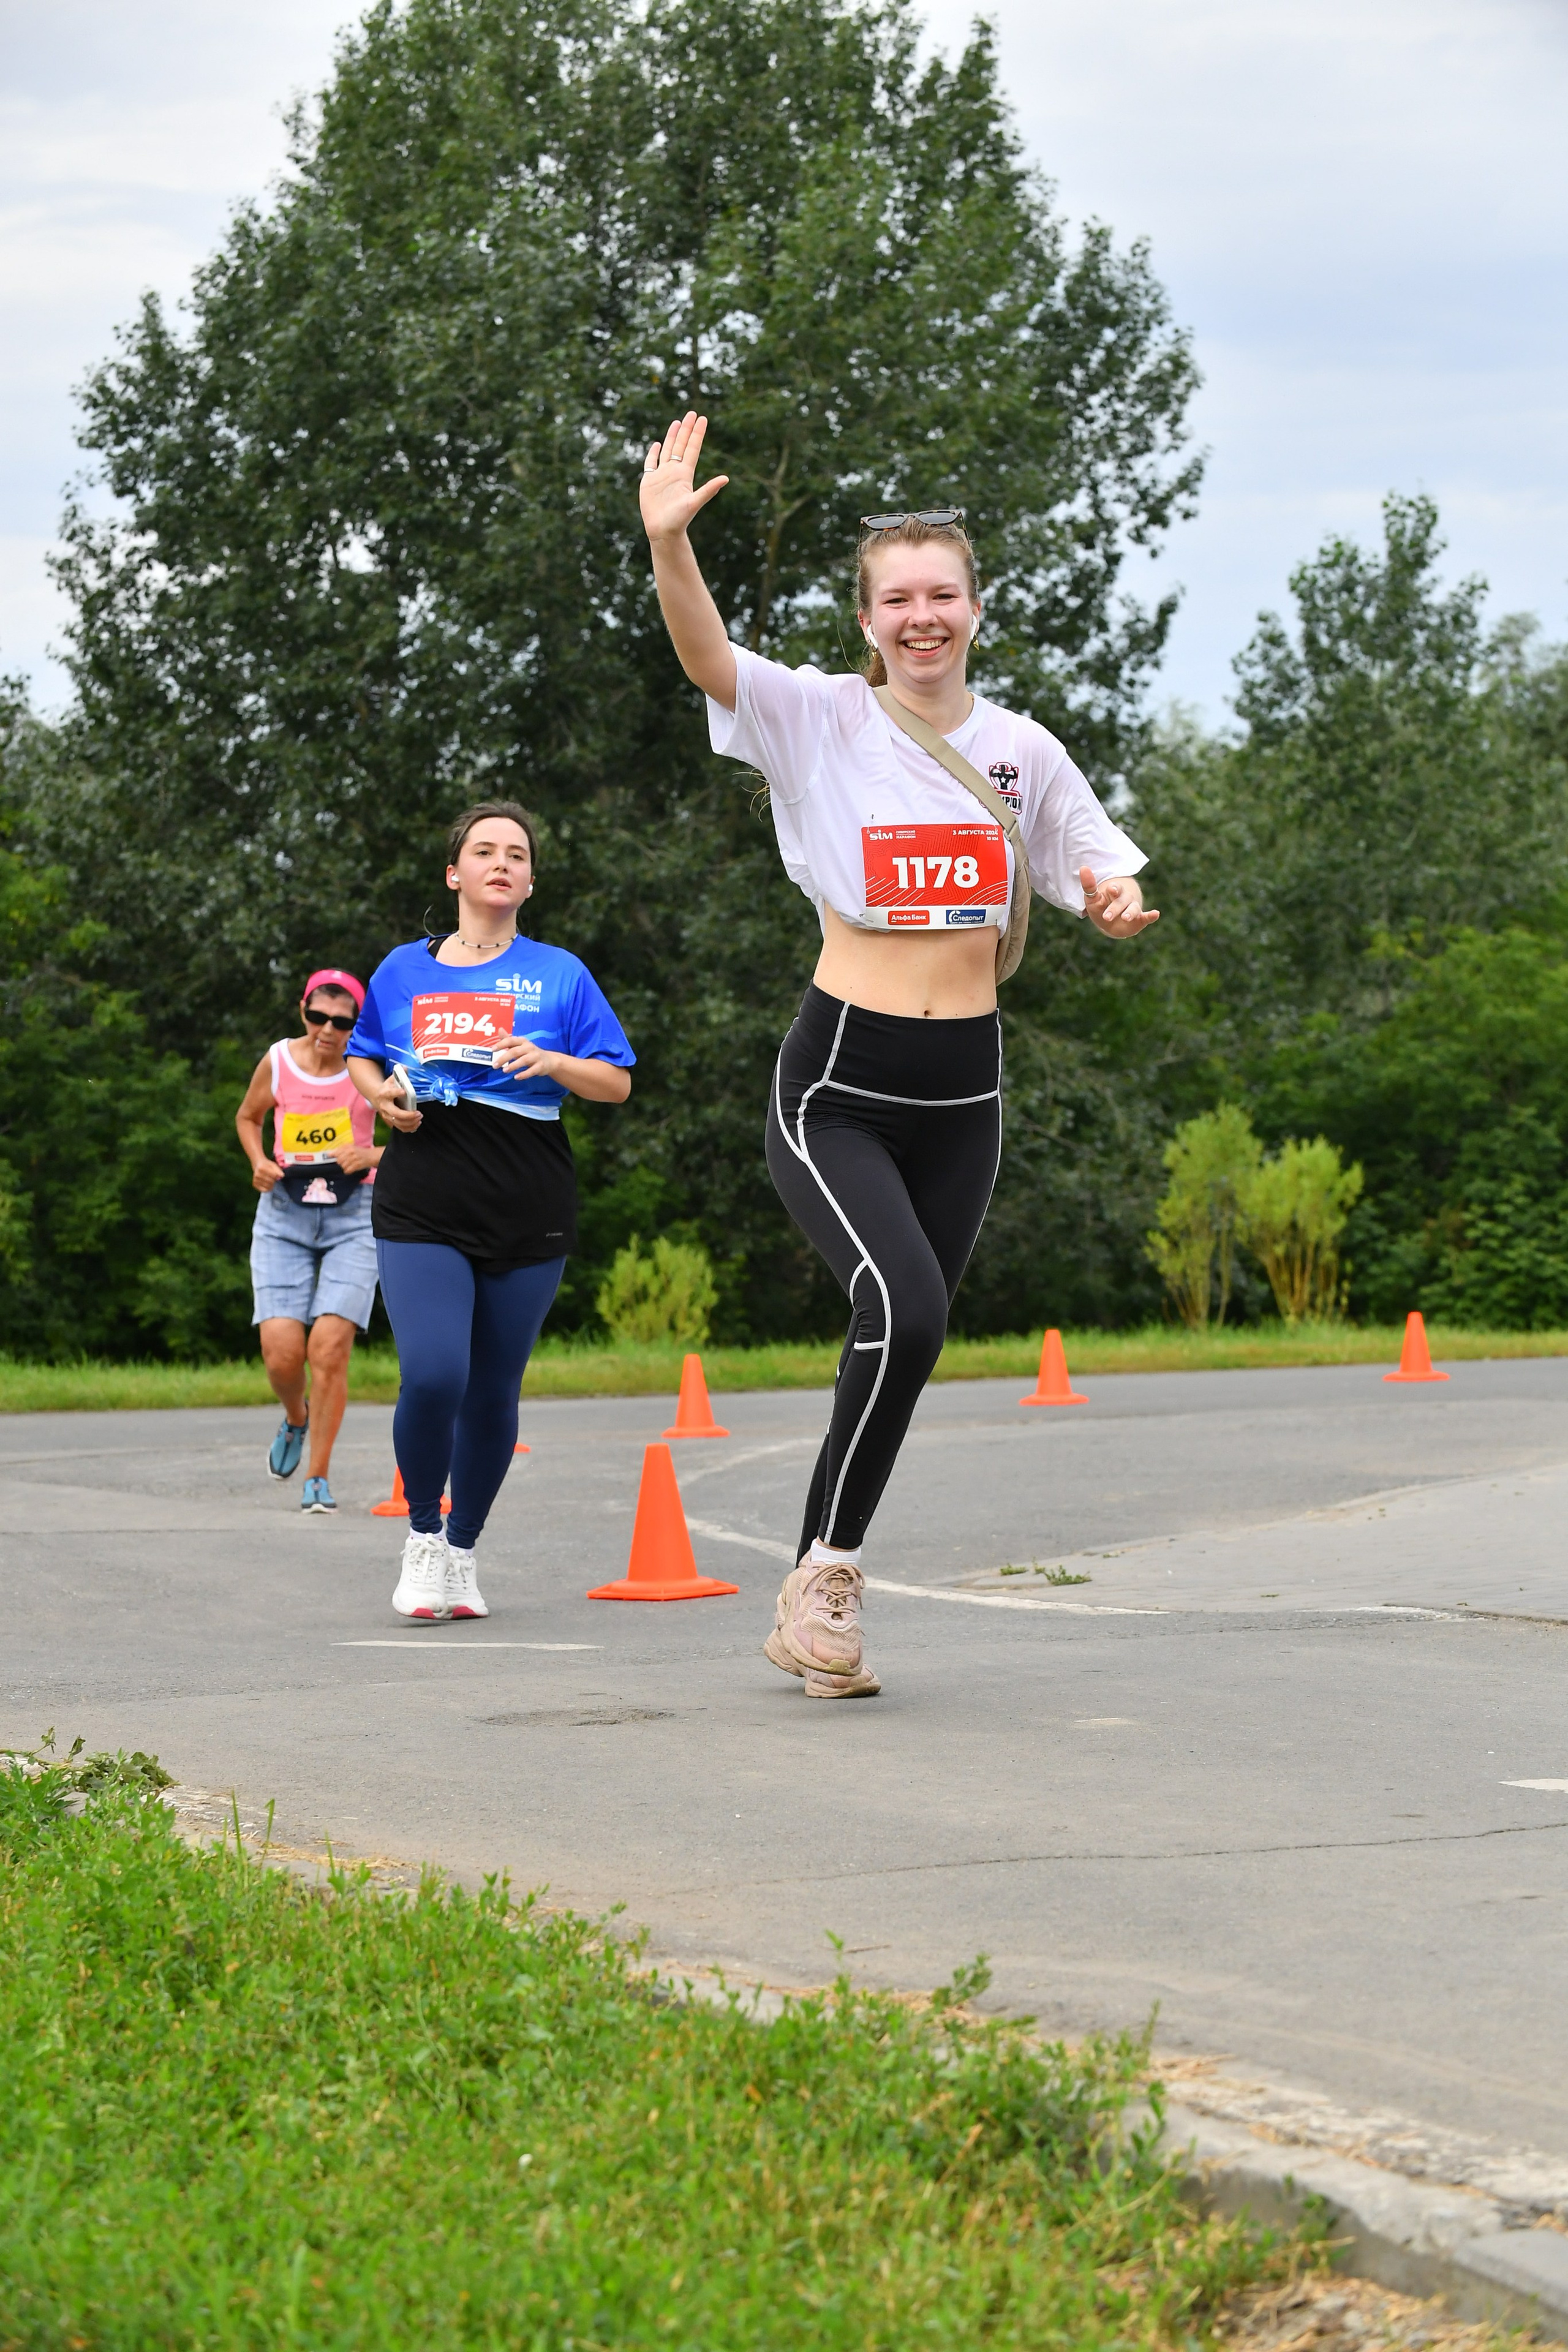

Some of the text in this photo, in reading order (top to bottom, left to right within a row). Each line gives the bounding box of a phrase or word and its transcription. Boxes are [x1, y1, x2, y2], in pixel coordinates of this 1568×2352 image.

[1002, 796, 1021, 811] PION
[892, 856, 979, 888] 1178
[514, 1004, 540, 1013] АФОН
[424, 1012, 496, 1036] 2194
[296, 1127, 336, 1145] 460
